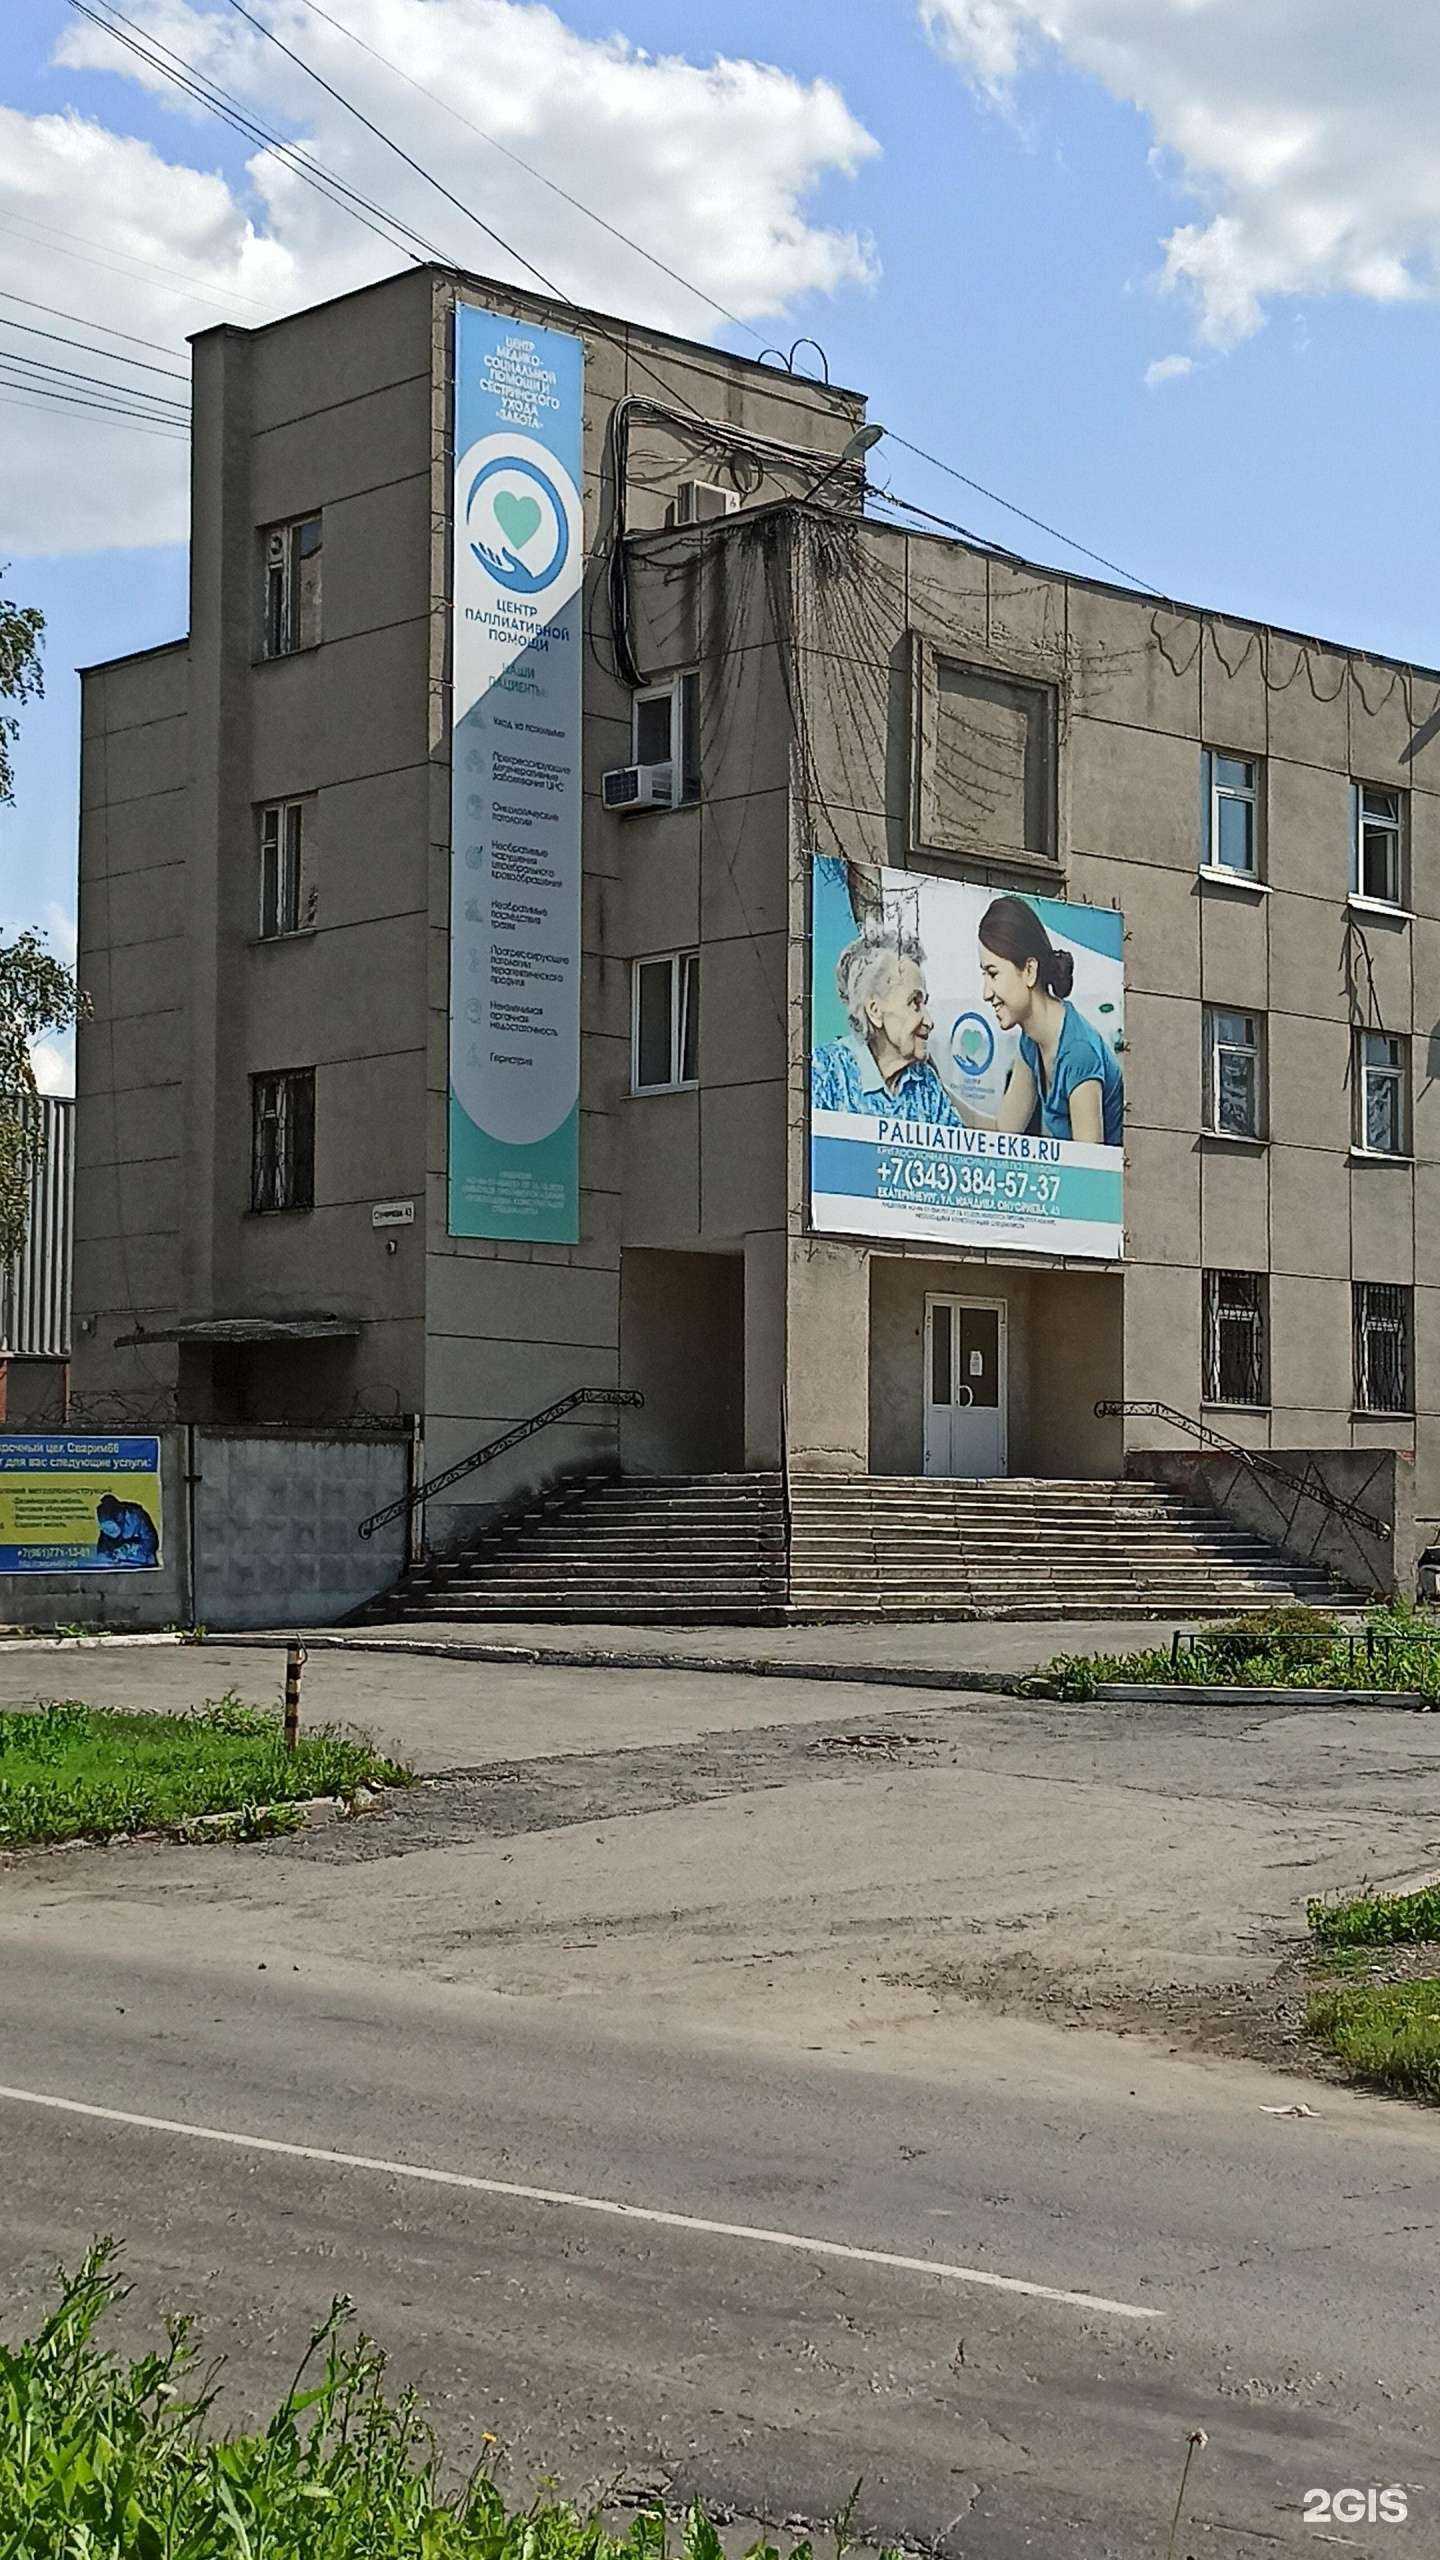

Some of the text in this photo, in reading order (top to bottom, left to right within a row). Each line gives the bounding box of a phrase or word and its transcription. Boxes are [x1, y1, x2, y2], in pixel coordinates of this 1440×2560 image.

[497, 599, 538, 617] ЦЕНТР
[465, 608, 570, 641] ПАЛЛИАТИВНОЙ
[489, 629, 549, 652] ПОМОЩИ
[879, 1119, 1060, 1161] PALLIATIVE-EKB.RU
[960, 1166, 1060, 1201] 384-57-37
[4, 1459, 26, 1470] для
[29, 1460, 48, 1468] вас
[50, 1459, 110, 1470] следующие
